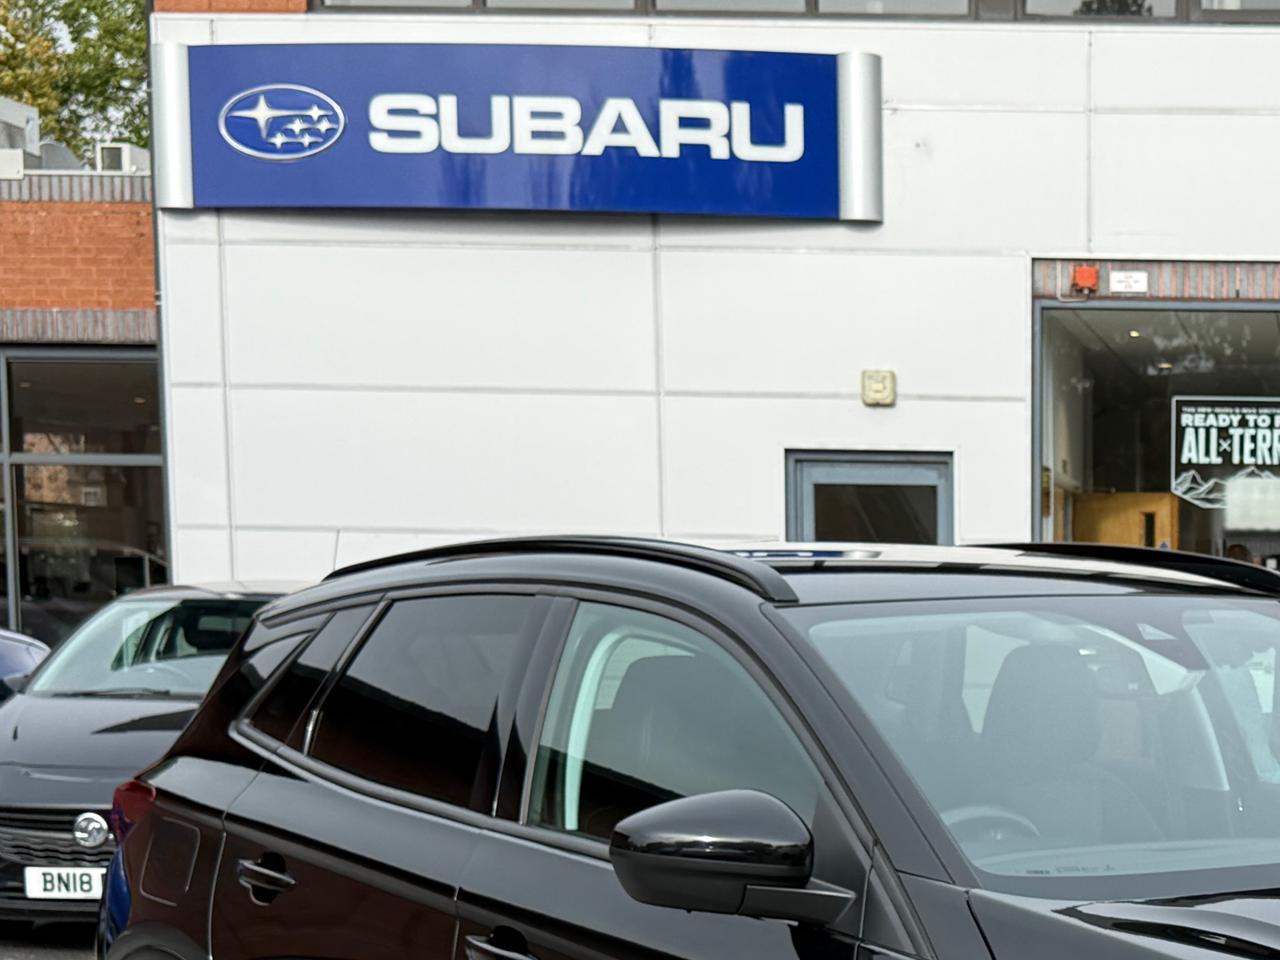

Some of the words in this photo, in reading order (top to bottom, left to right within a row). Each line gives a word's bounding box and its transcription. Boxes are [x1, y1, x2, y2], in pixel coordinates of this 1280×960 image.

[367, 93, 806, 163] SUBARU
[1180, 413, 1241, 428] READY
[1245, 414, 1271, 428] TO
[42, 872, 93, 893] BN18
